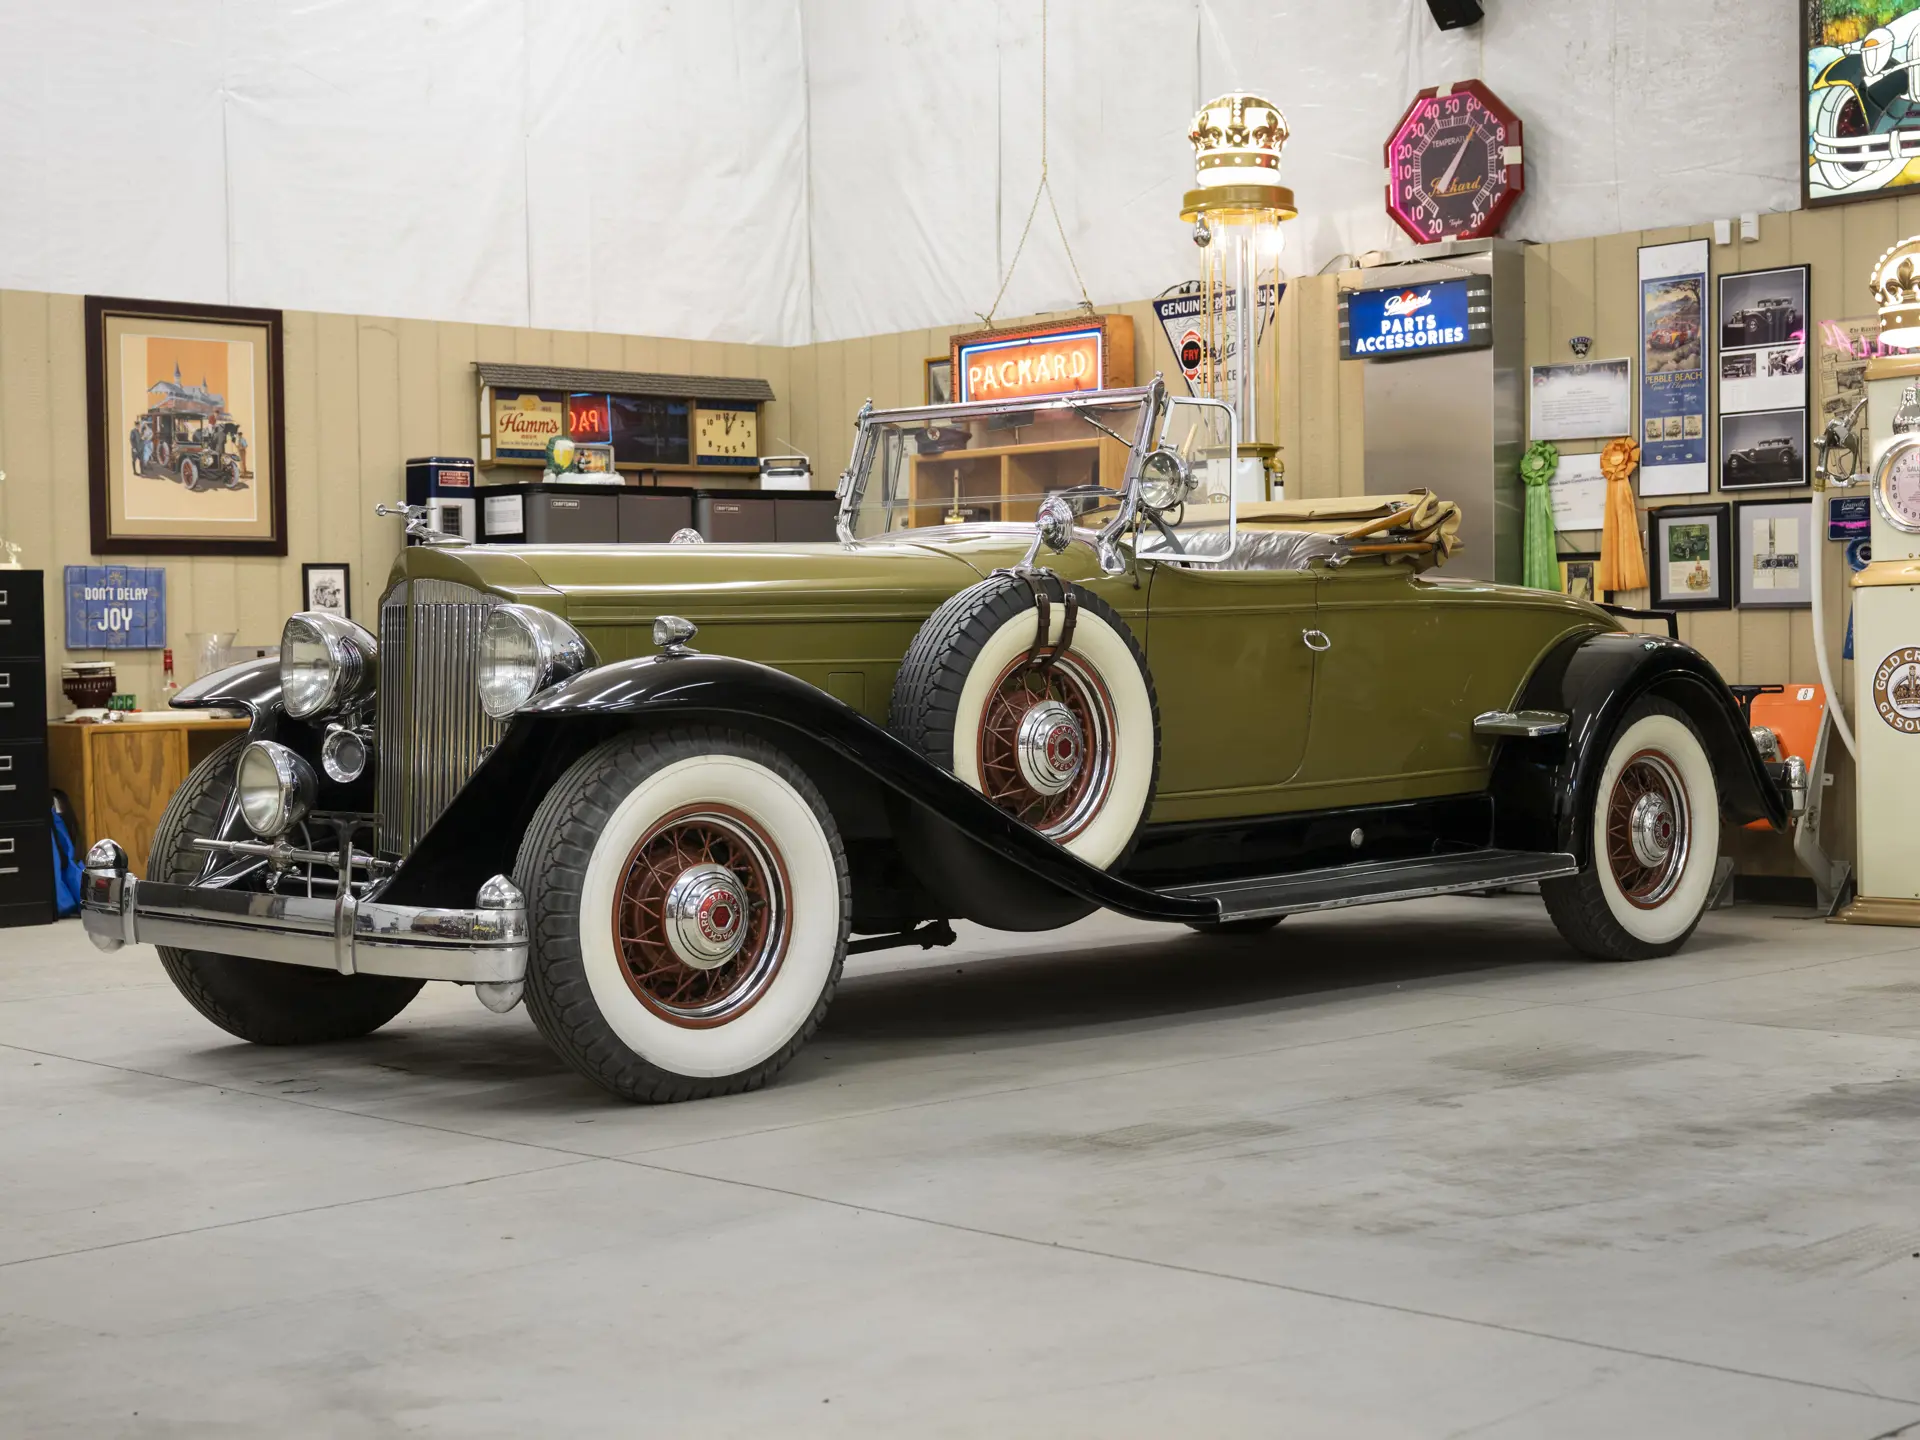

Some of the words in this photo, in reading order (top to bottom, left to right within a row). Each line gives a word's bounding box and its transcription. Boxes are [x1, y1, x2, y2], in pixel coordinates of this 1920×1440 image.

[1424, 104, 1440, 119] 40
[1445, 99, 1460, 114] 50
[1466, 98, 1481, 112] 60
[1411, 123, 1425, 138] 30
[1398, 144, 1412, 159] 20
[1400, 165, 1411, 180] 10
[1405, 185, 1412, 200] 0
[1411, 205, 1424, 221] 10
[1470, 212, 1485, 228] 20
[1428, 219, 1443, 234] 20
[1381, 314, 1437, 335] PARTS
[1355, 326, 1465, 353] ACCESSORIES
[1183, 348, 1200, 361] FRY
[969, 350, 1086, 395] PACKARD
[1645, 374, 1673, 385] PEBBLE
[1674, 371, 1703, 381] BEACH
[499, 412, 560, 434] Hamm's
[740, 420, 745, 428] 2
[724, 446, 729, 454] 6
[85, 587, 114, 600] DON'T
[117, 588, 148, 600] DELAY
[97, 607, 133, 631] JOY
[1876, 655, 1900, 690] GOLD
[1803, 689, 1809, 699] 8
[709, 893, 740, 917] TWELVE
[700, 911, 734, 941] PACKARD
